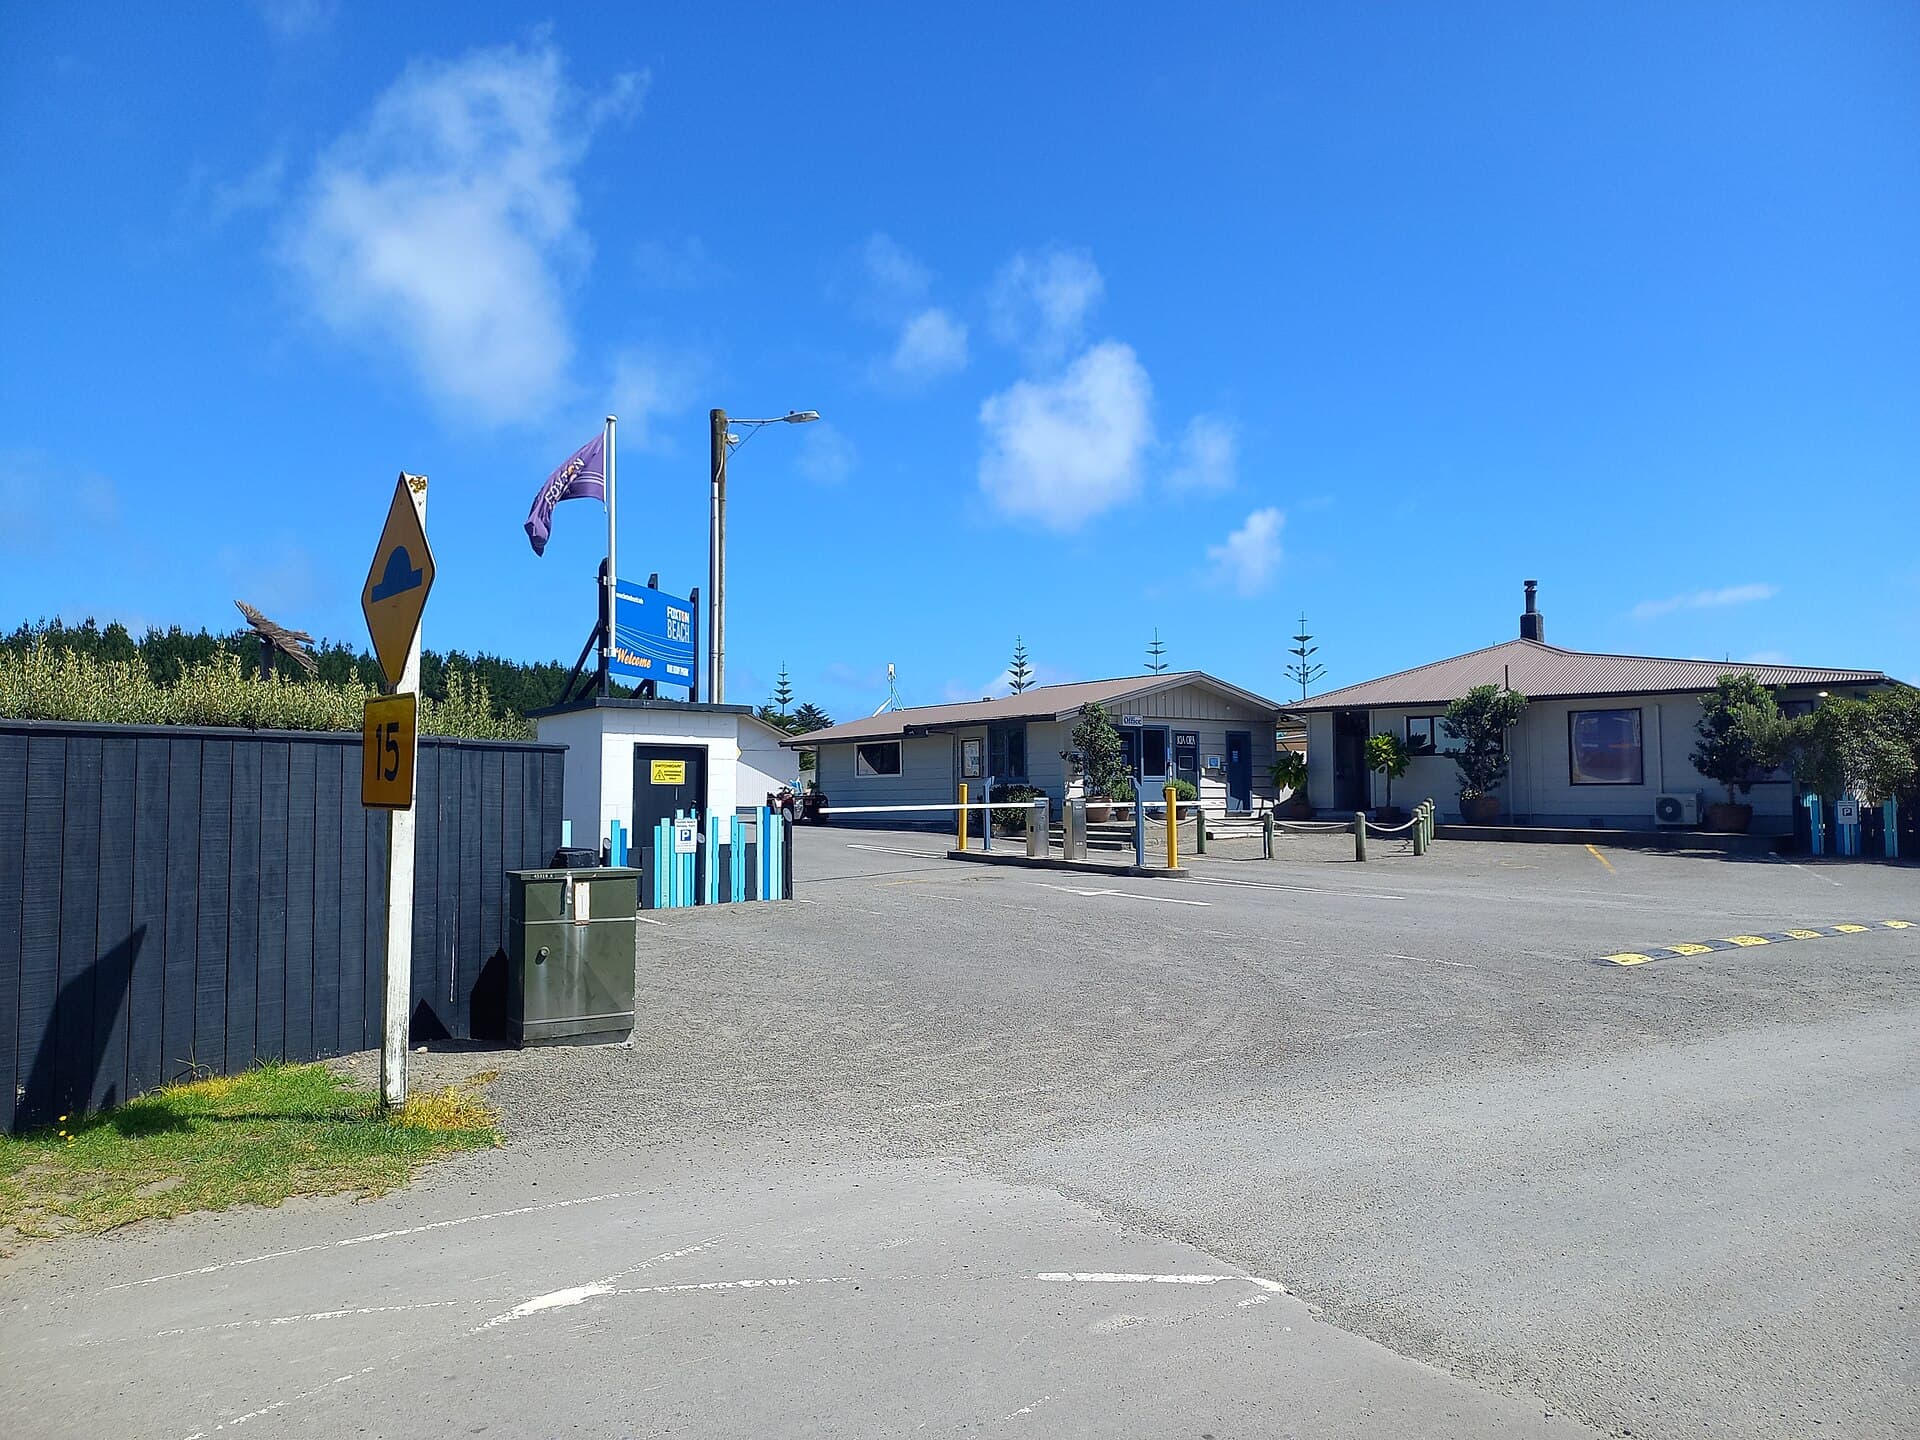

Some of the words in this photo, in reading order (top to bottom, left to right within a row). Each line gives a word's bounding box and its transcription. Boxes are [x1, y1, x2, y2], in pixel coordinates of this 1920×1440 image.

[667, 606, 690, 623] FOXTON
[667, 619, 690, 643] BEACH
[616, 648, 652, 668] Welcome
[376, 722, 400, 781] 15
